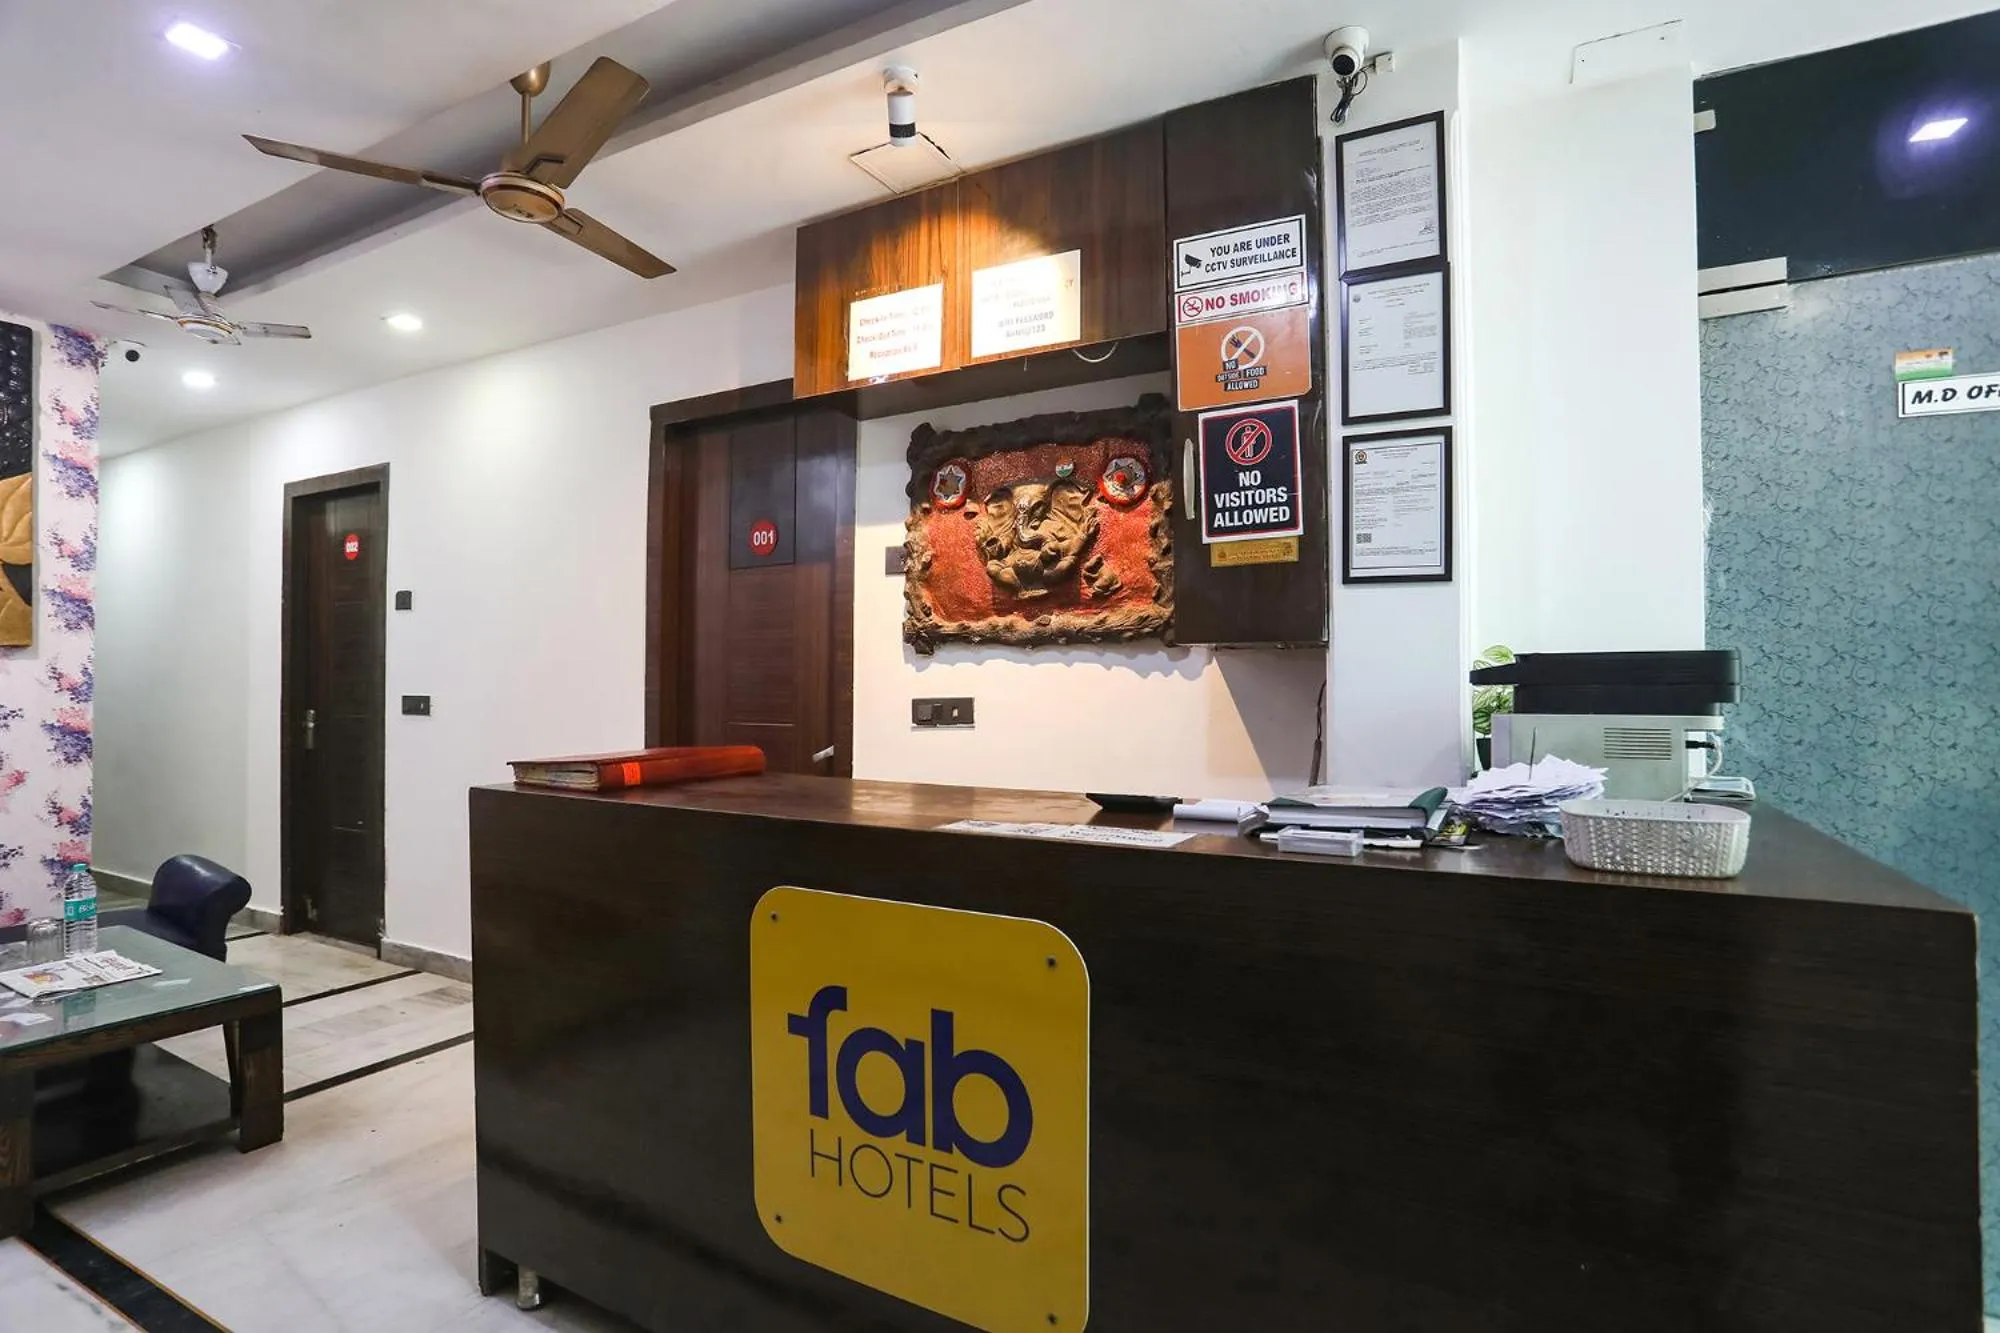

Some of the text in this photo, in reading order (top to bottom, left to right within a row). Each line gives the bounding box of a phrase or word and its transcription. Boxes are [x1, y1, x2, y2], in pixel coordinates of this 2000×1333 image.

[1210, 233, 1290, 258] YOU ARE UNDER
[1204, 247, 1297, 273] CCTV SURVEILLANCE
[1205, 281, 1298, 311] NO SMOKG
[1225, 360, 1237, 370] NO
[1245, 367, 1265, 378] FOOD
[1227, 380, 1258, 390] ALLOWED
[1911, 383, 2000, 405] M.D OF
[1239, 470, 1262, 487] NO
[1214, 486, 1288, 508] VISITORS
[1213, 506, 1290, 528] ALLOWED
[753, 530, 774, 546] 001
[787, 985, 1033, 1169] fab
[810, 1128, 1030, 1243] HOTELS
